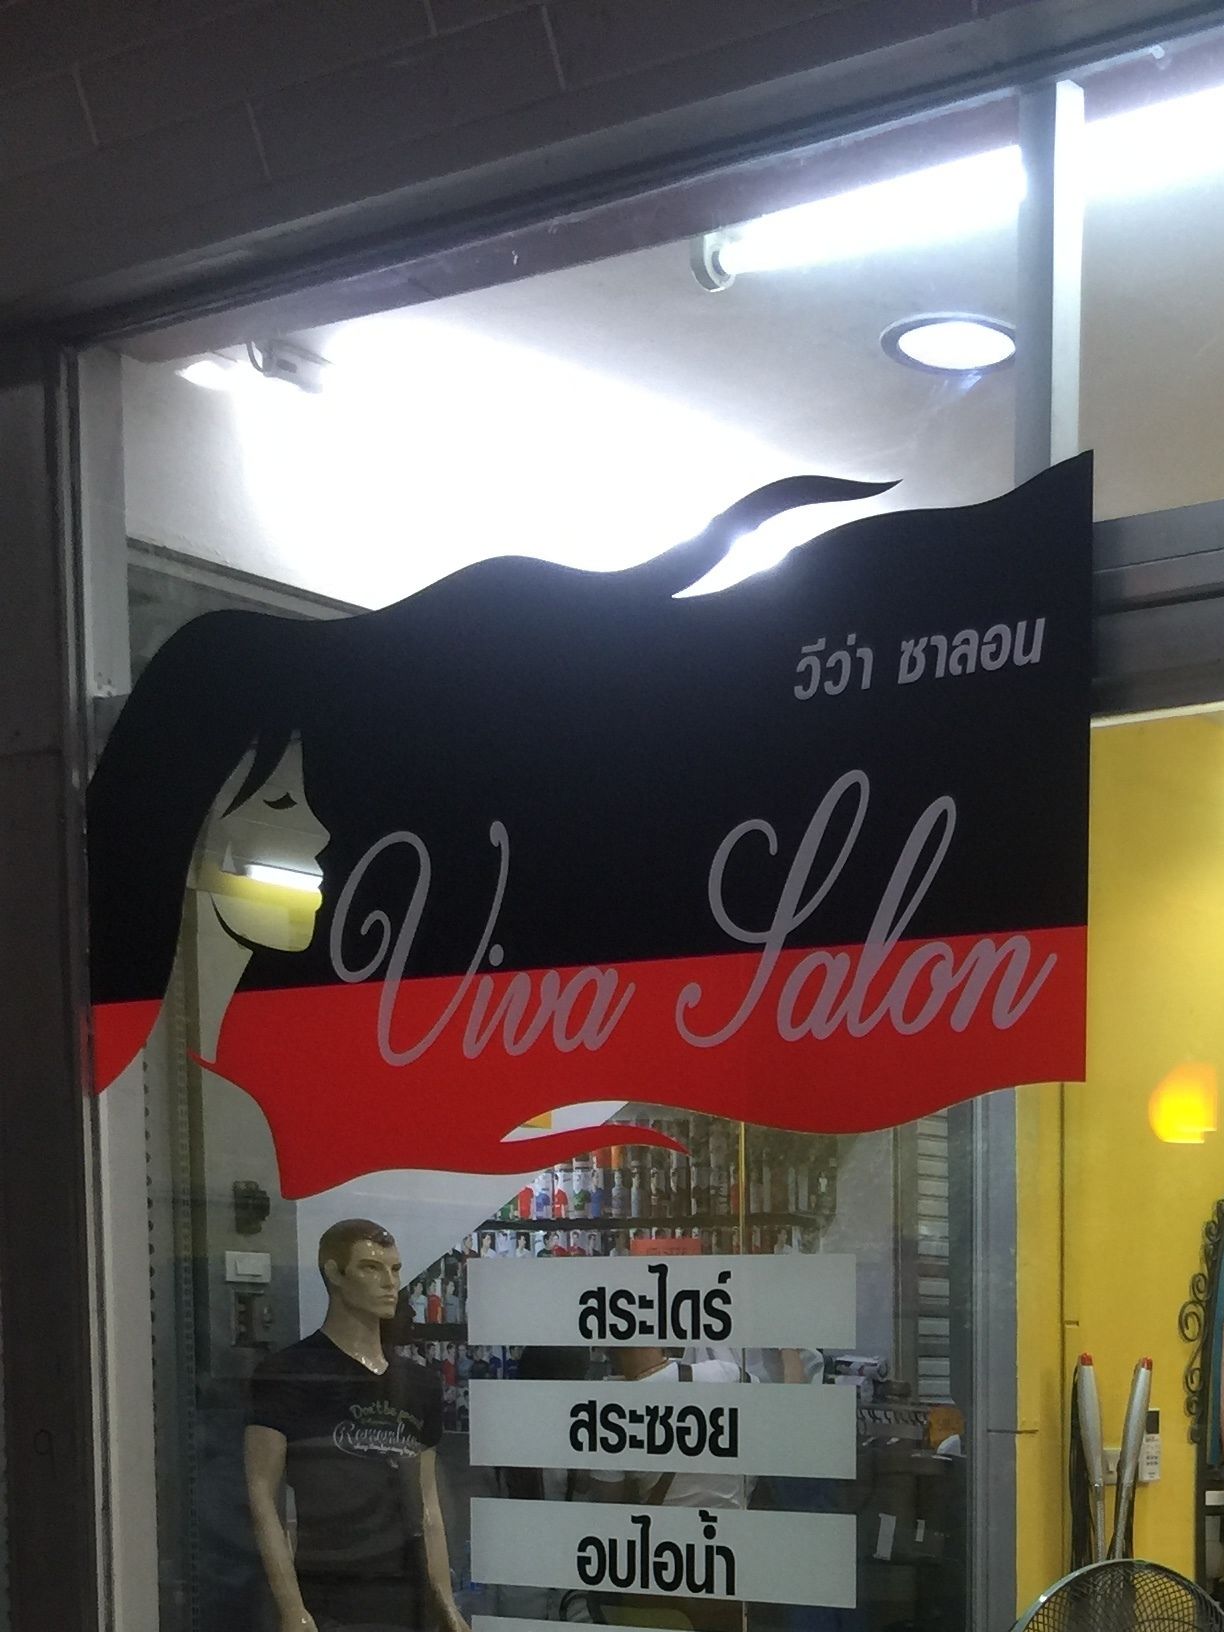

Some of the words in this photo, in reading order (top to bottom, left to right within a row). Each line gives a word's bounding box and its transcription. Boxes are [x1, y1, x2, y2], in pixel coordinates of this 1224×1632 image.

[794, 633, 874, 700] วีว่า
[898, 617, 1046, 684] ซาลอน
[330, 820, 636, 1067] Viva
[676, 769, 1058, 1048] Salon
[578, 1263, 732, 1341] สระไดร์
[569, 1399, 739, 1458] สระซอย
[576, 1509, 736, 1596] อบไอน้ำ
